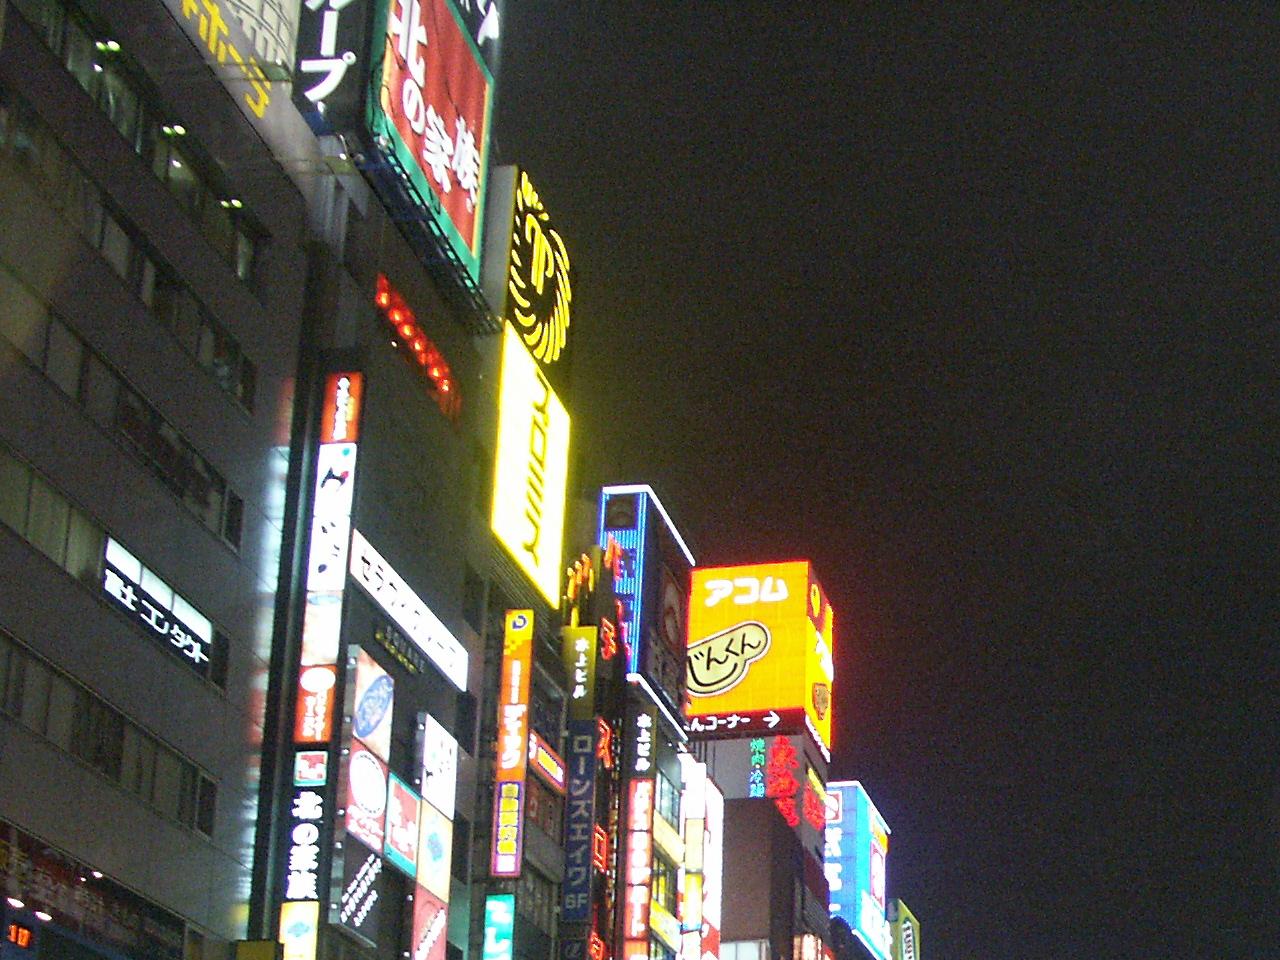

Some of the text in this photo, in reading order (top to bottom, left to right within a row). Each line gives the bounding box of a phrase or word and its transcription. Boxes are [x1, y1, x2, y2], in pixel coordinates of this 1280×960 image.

[300, 0, 356, 102] ープ
[703, 576, 789, 608] アコム
